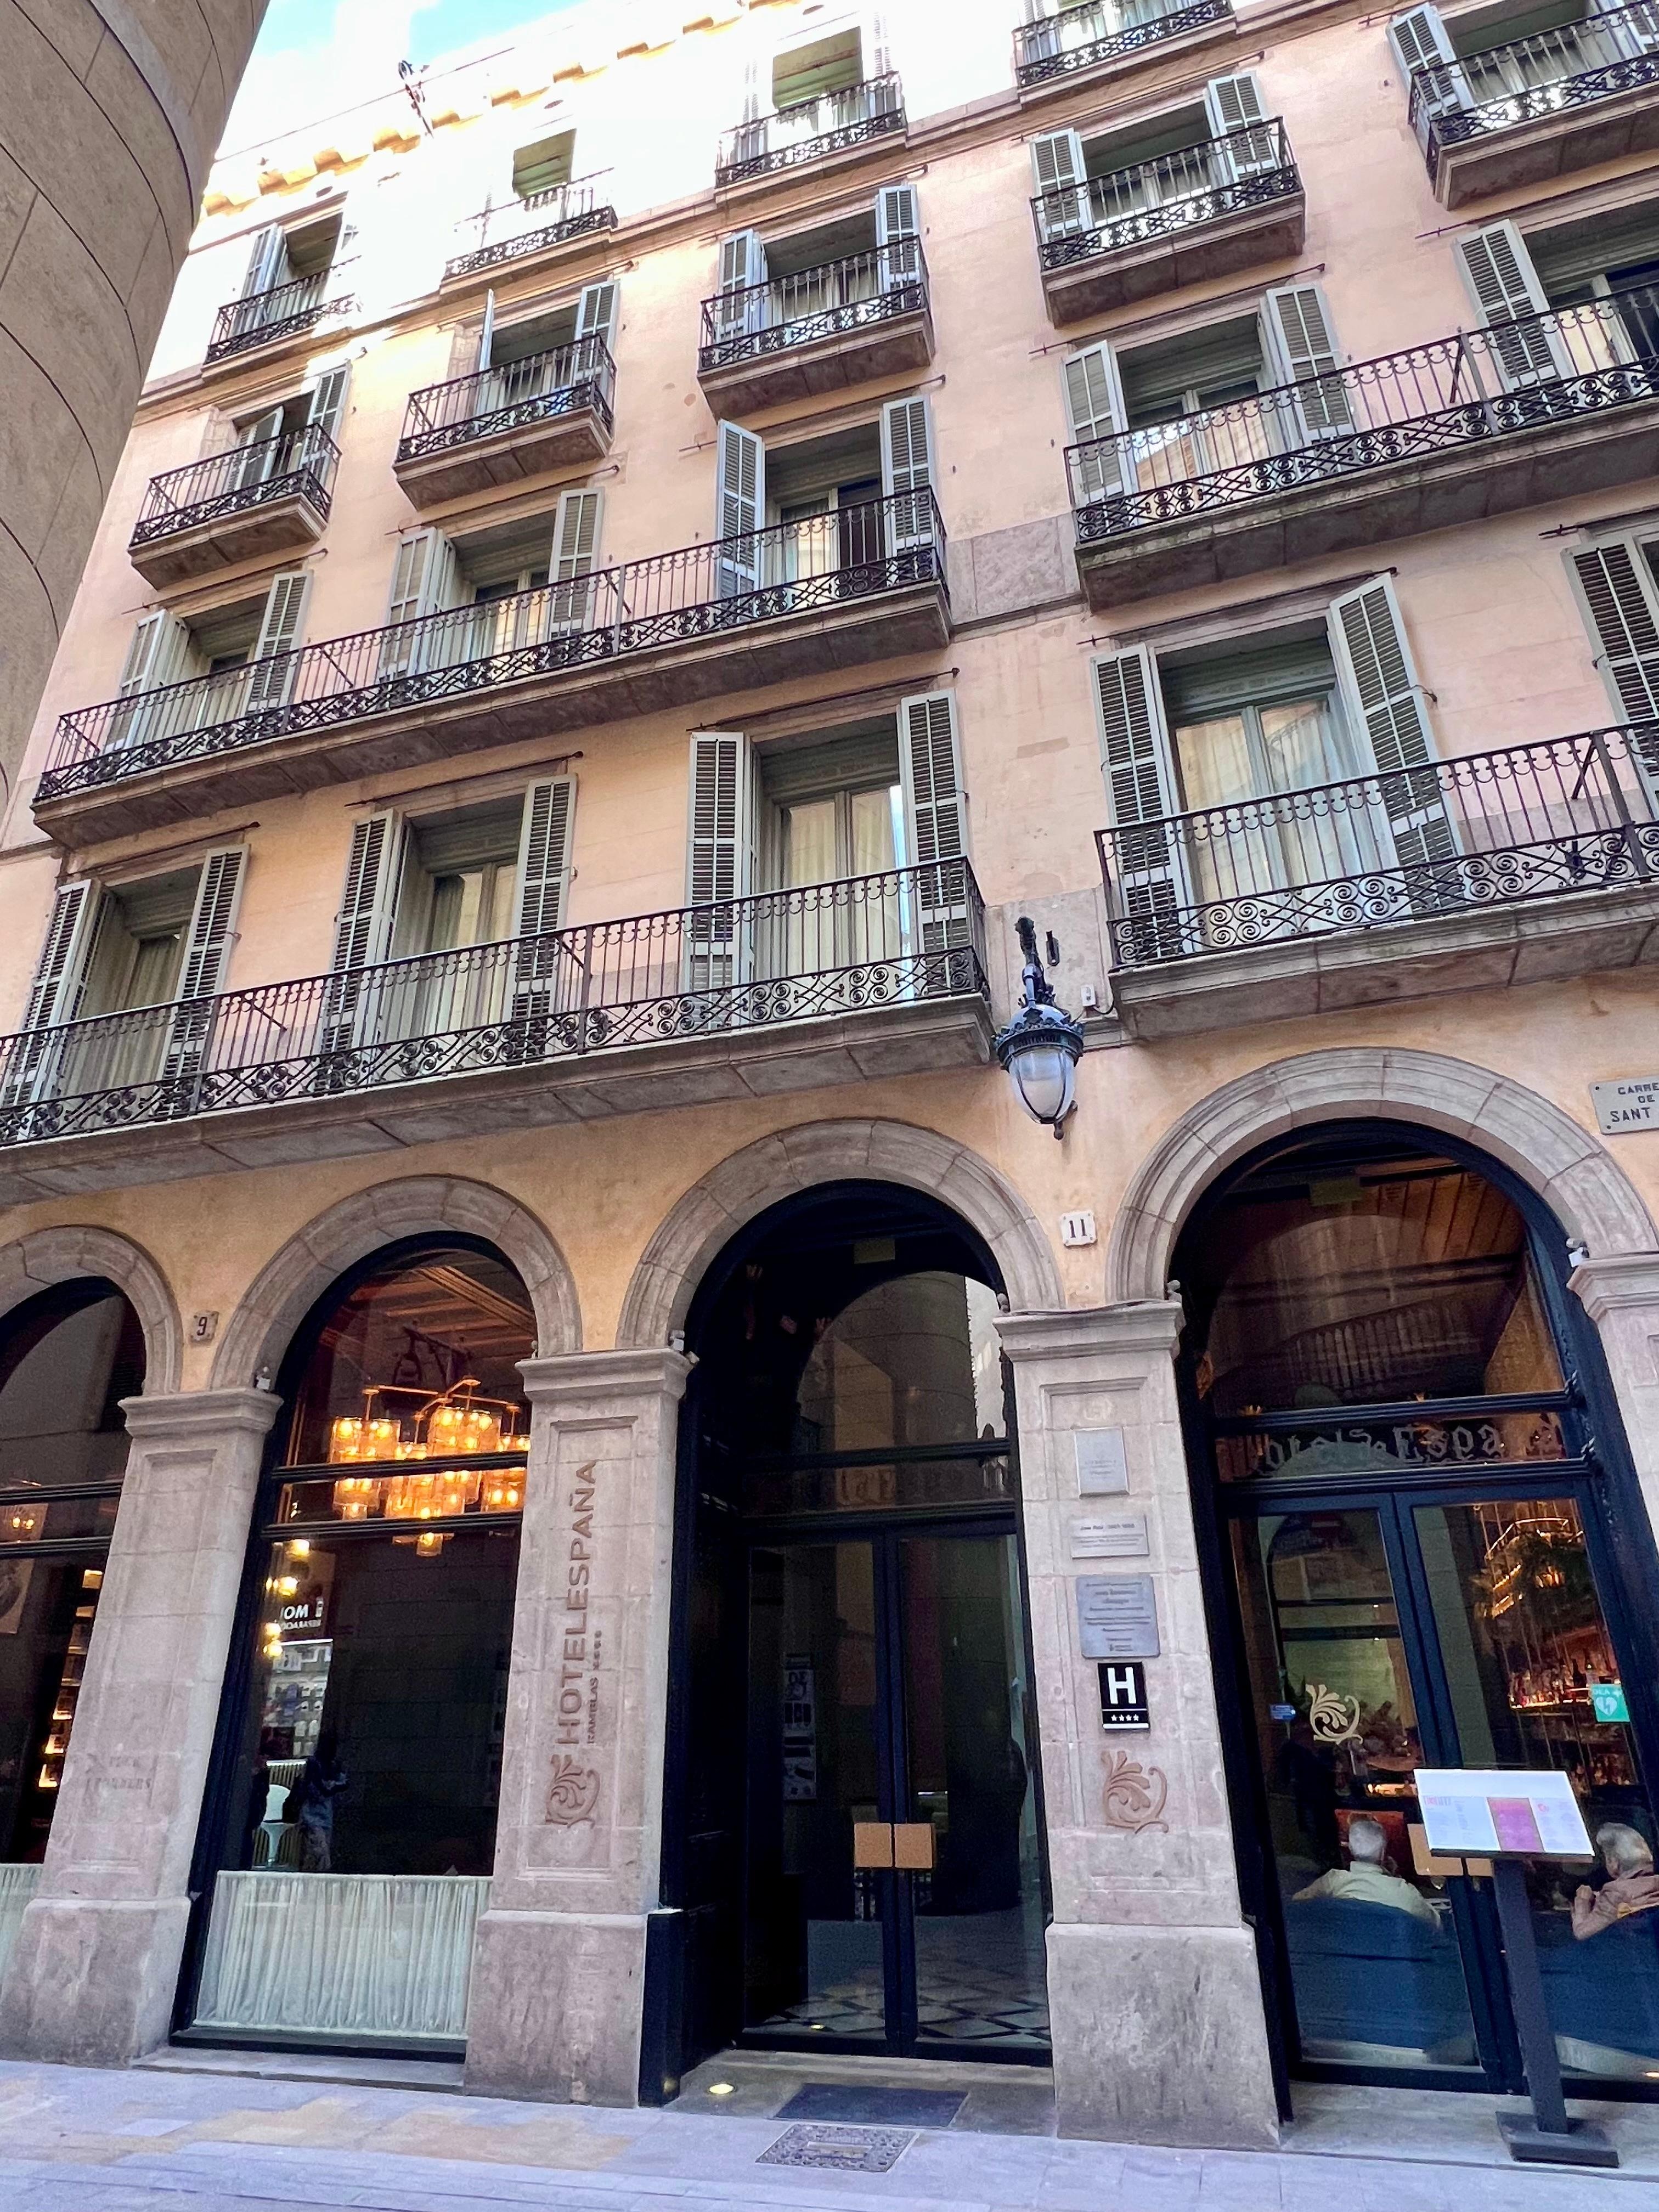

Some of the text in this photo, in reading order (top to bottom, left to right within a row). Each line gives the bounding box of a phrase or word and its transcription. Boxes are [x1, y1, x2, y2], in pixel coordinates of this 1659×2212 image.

[1638, 1095, 1655, 1103] DE
[1610, 1107, 1650, 1122] SANT
[1069, 1218, 1087, 1238] 11
[196, 1316, 207, 1336] 9
[556, 1459, 597, 1745] HOTEL ESPAÑA
[1107, 1667, 1137, 1704] H
